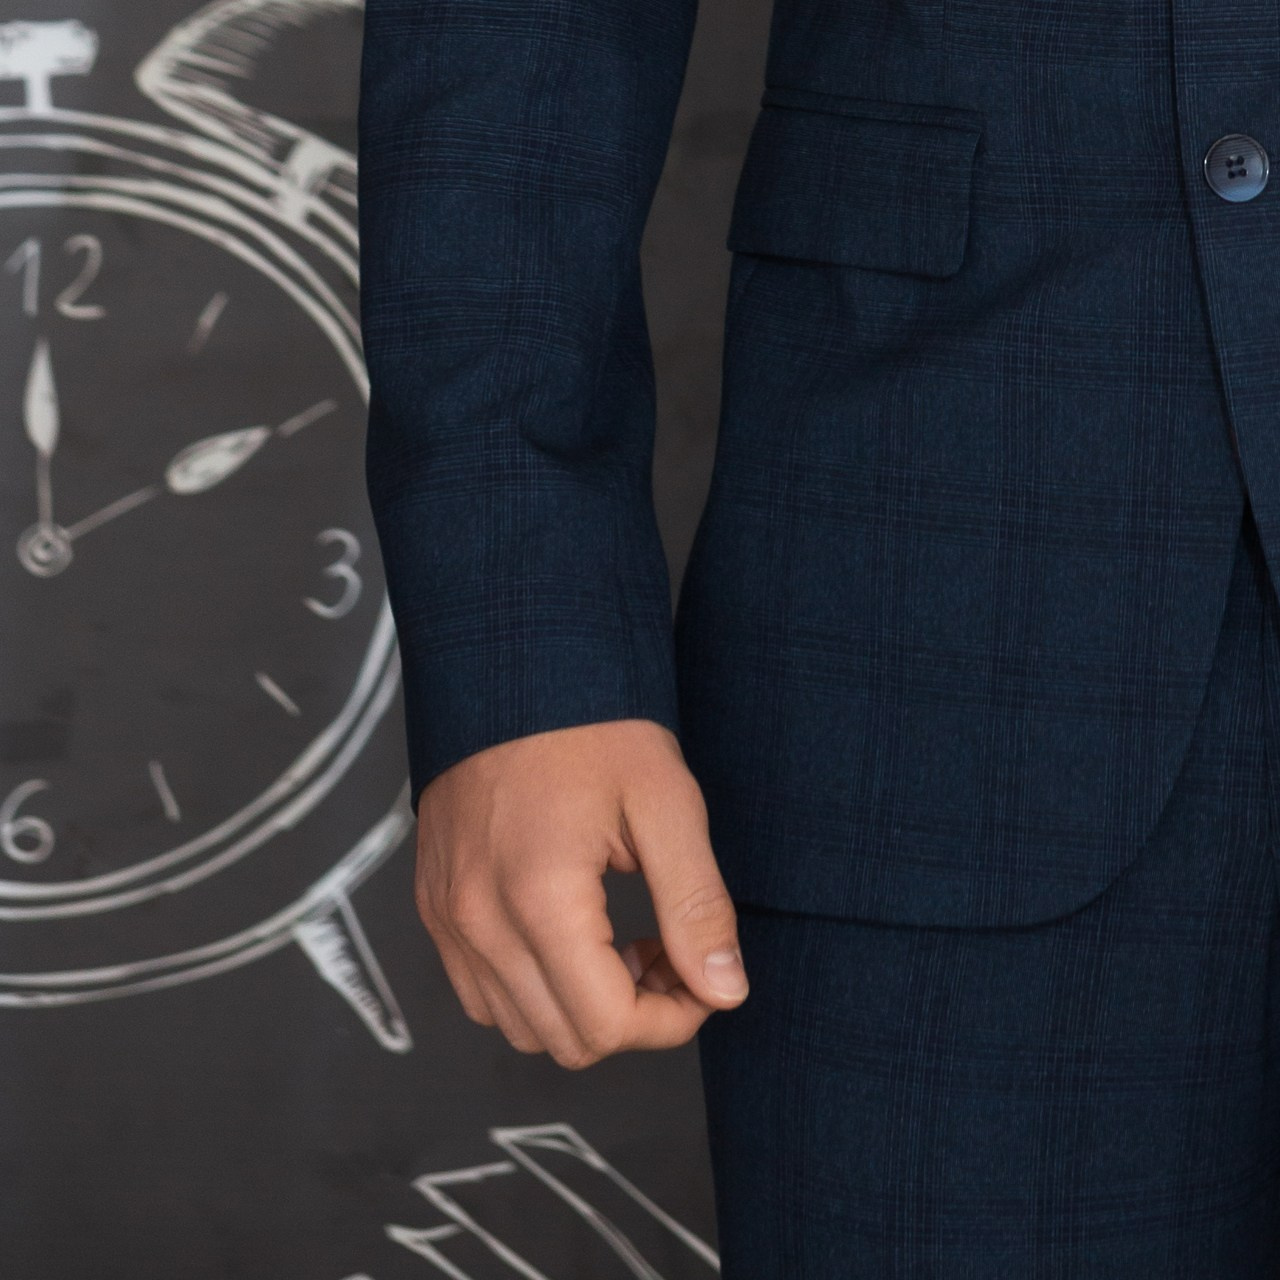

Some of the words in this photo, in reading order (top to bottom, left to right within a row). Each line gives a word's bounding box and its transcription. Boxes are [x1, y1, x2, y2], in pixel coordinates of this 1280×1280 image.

[4, 233, 107, 319] 12
[303, 527, 363, 621] 3
[0, 777, 55, 865] 6
